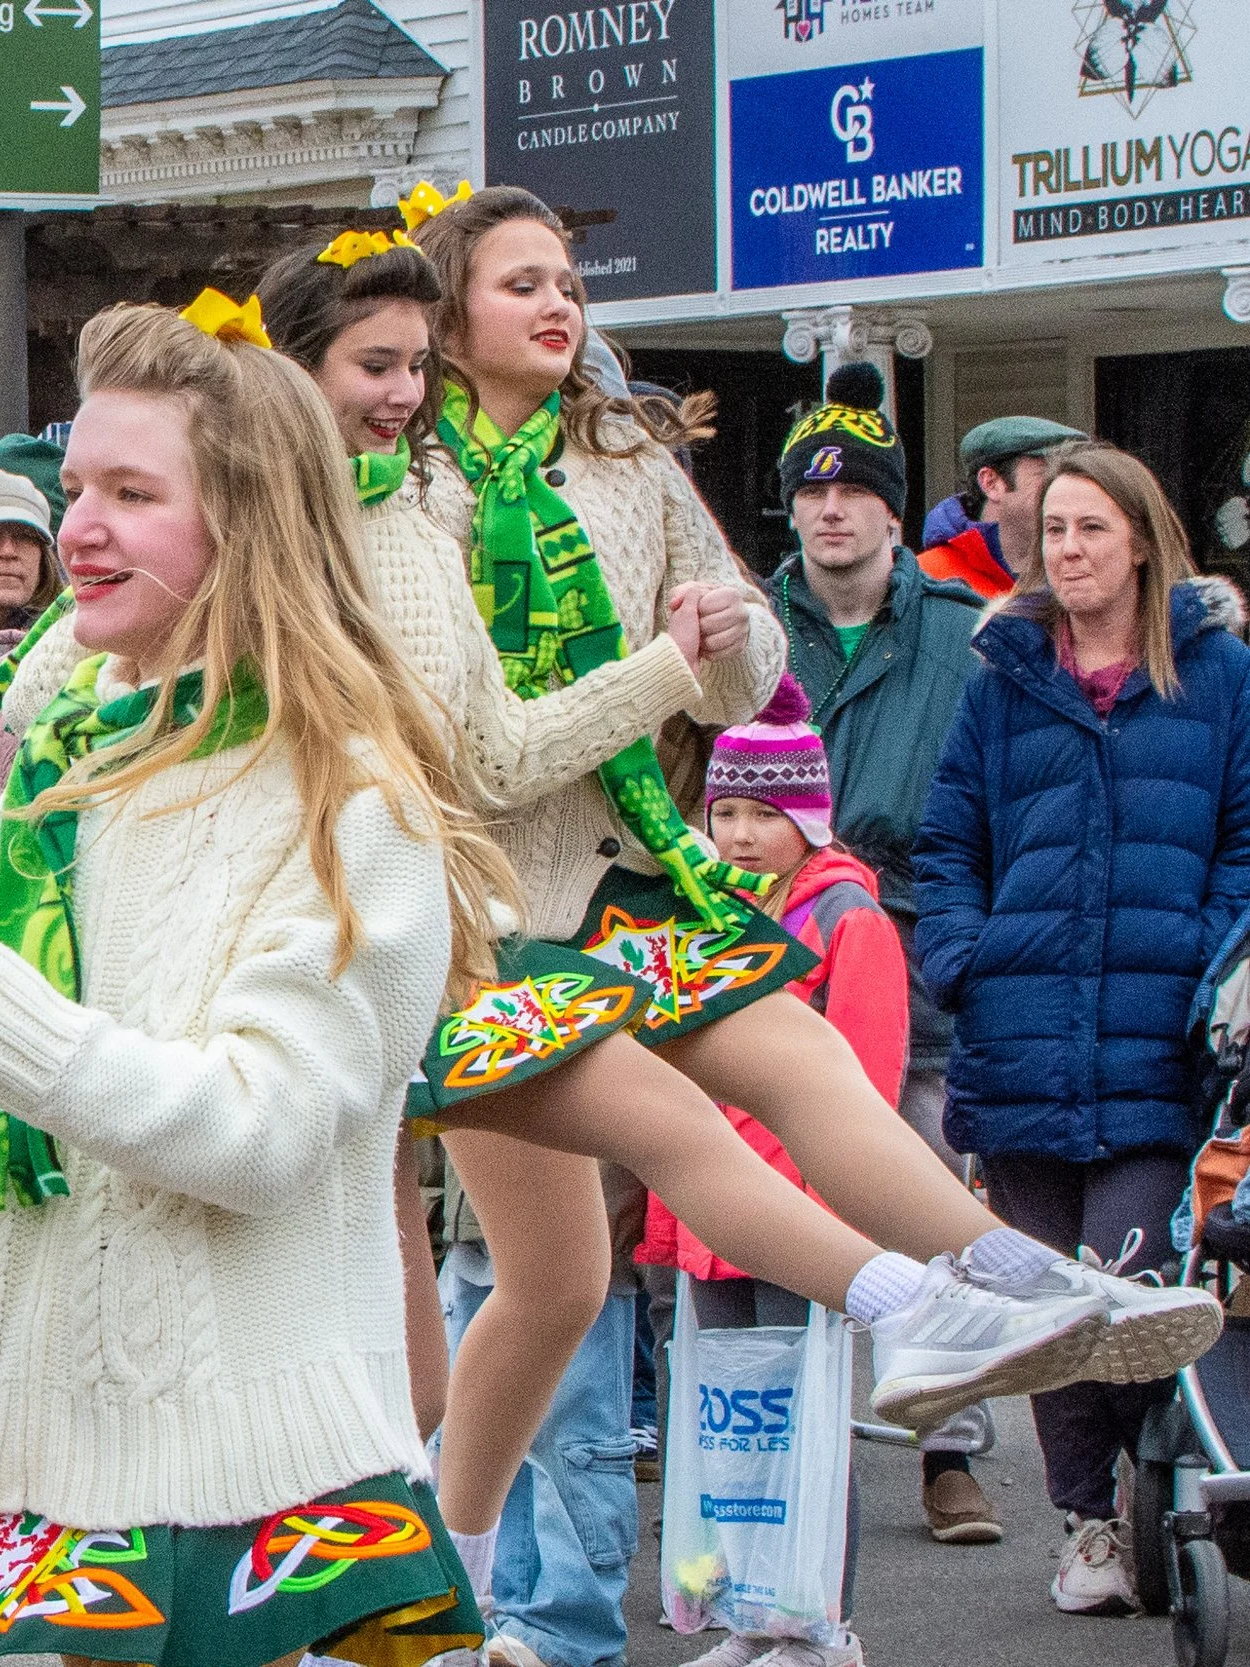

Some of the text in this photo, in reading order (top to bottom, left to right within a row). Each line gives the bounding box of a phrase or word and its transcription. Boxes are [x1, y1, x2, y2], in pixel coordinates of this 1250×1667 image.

[518, 0, 676, 61] ROMNEY
[840, 0, 934, 25] HOMES TEAM
[519, 58, 678, 104] BROWN
[517, 111, 680, 151] CANDLE COMPANY
[1012, 135, 1162, 198] TRILLIUM
[750, 165, 962, 216] COLDWELL BANKER
[1018, 189, 1250, 238] MIND BODY HEAR
[816, 221, 894, 255] REALTY
[577, 256, 637, 277] blished 2021
[719, 1437, 750, 1452] FOR
[756, 1436, 790, 1452] LES
